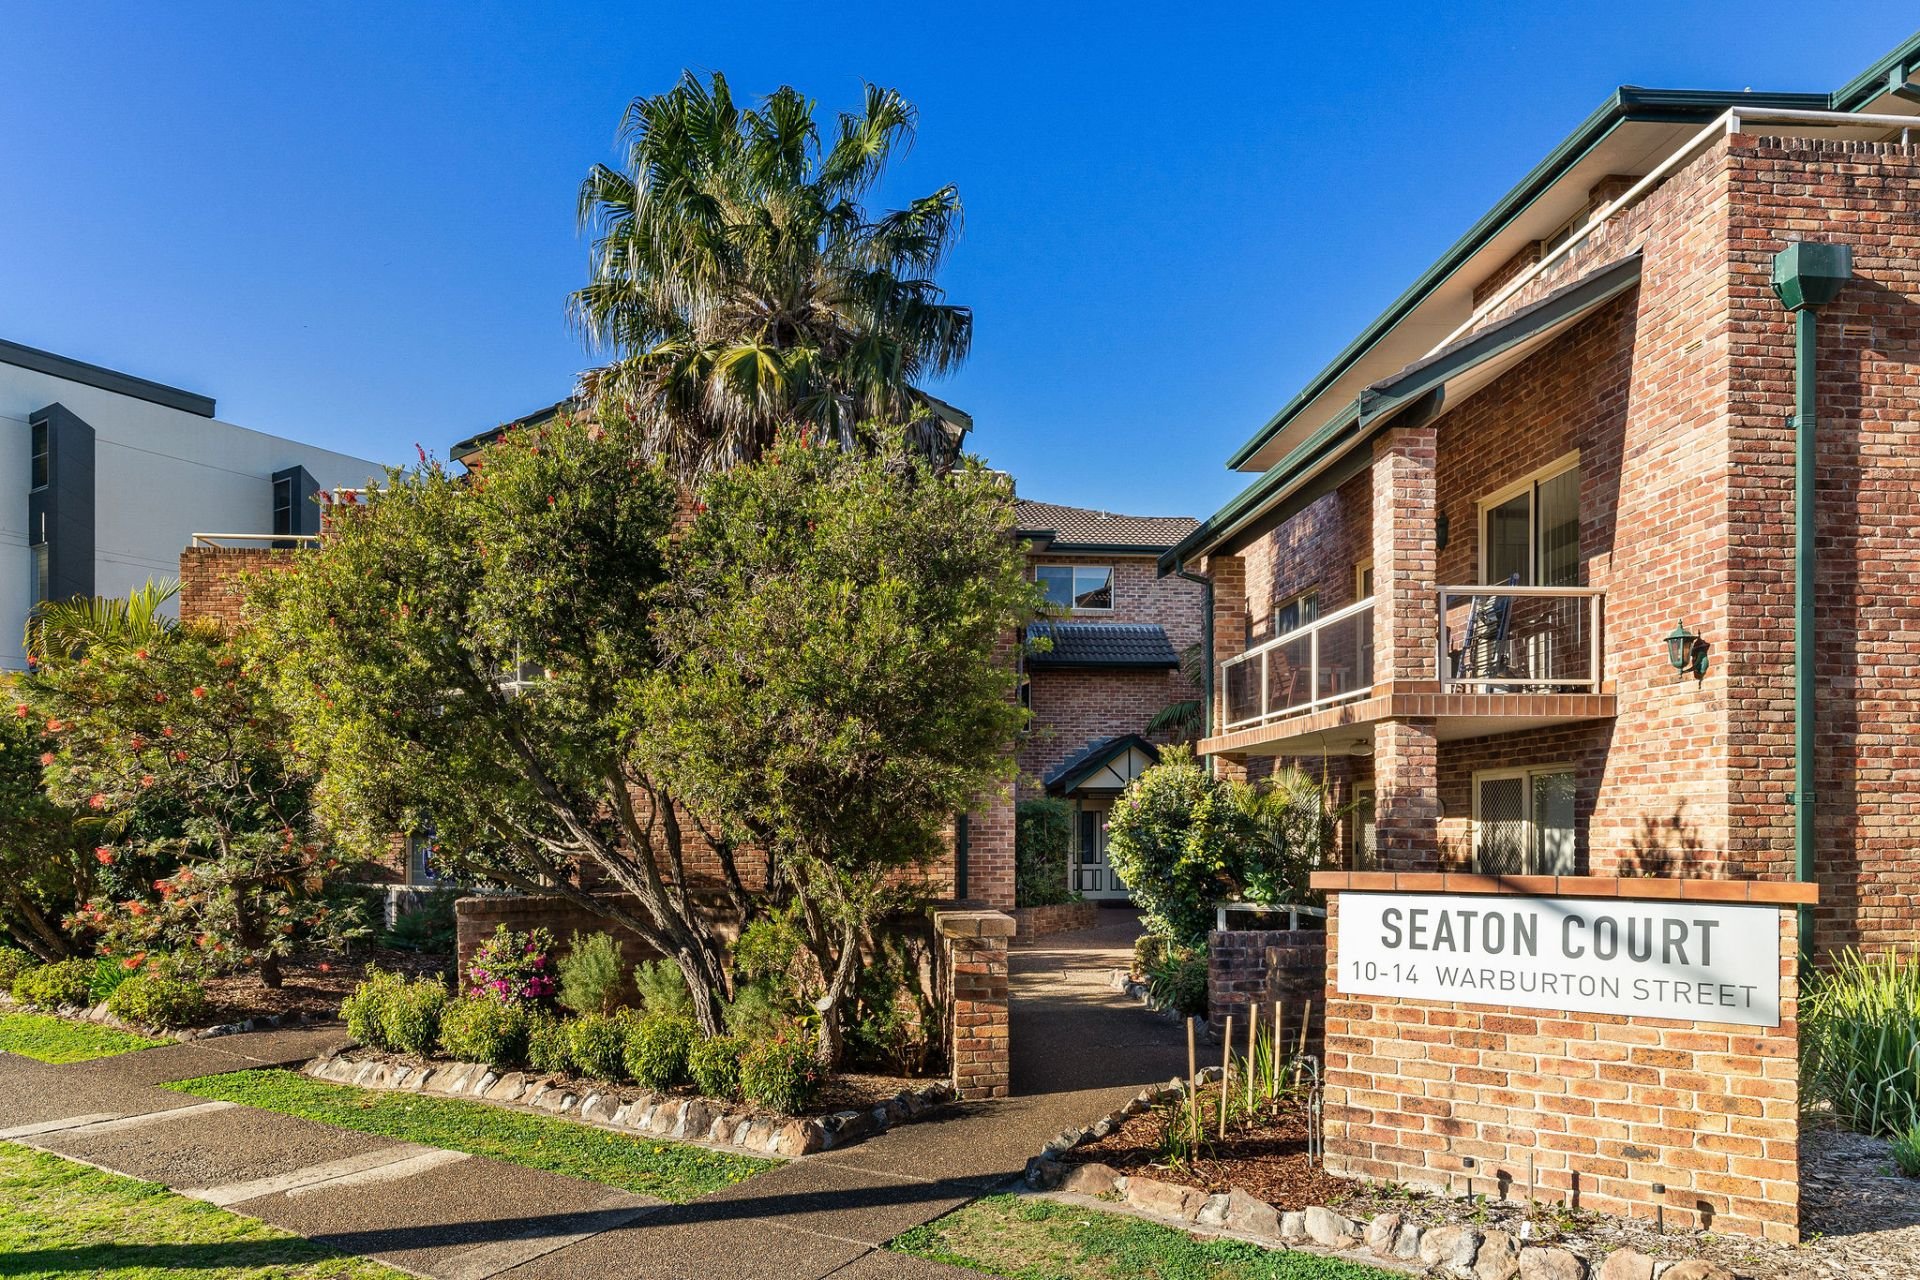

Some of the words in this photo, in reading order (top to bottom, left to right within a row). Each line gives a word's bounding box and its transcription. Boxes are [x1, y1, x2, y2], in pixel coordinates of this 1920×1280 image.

[1381, 907, 1538, 957] SEATON
[1561, 914, 1720, 967] COURT
[1352, 961, 1419, 985] 10-14
[1435, 965, 1620, 999] WARBURTON
[1632, 978, 1758, 1009] STREET
